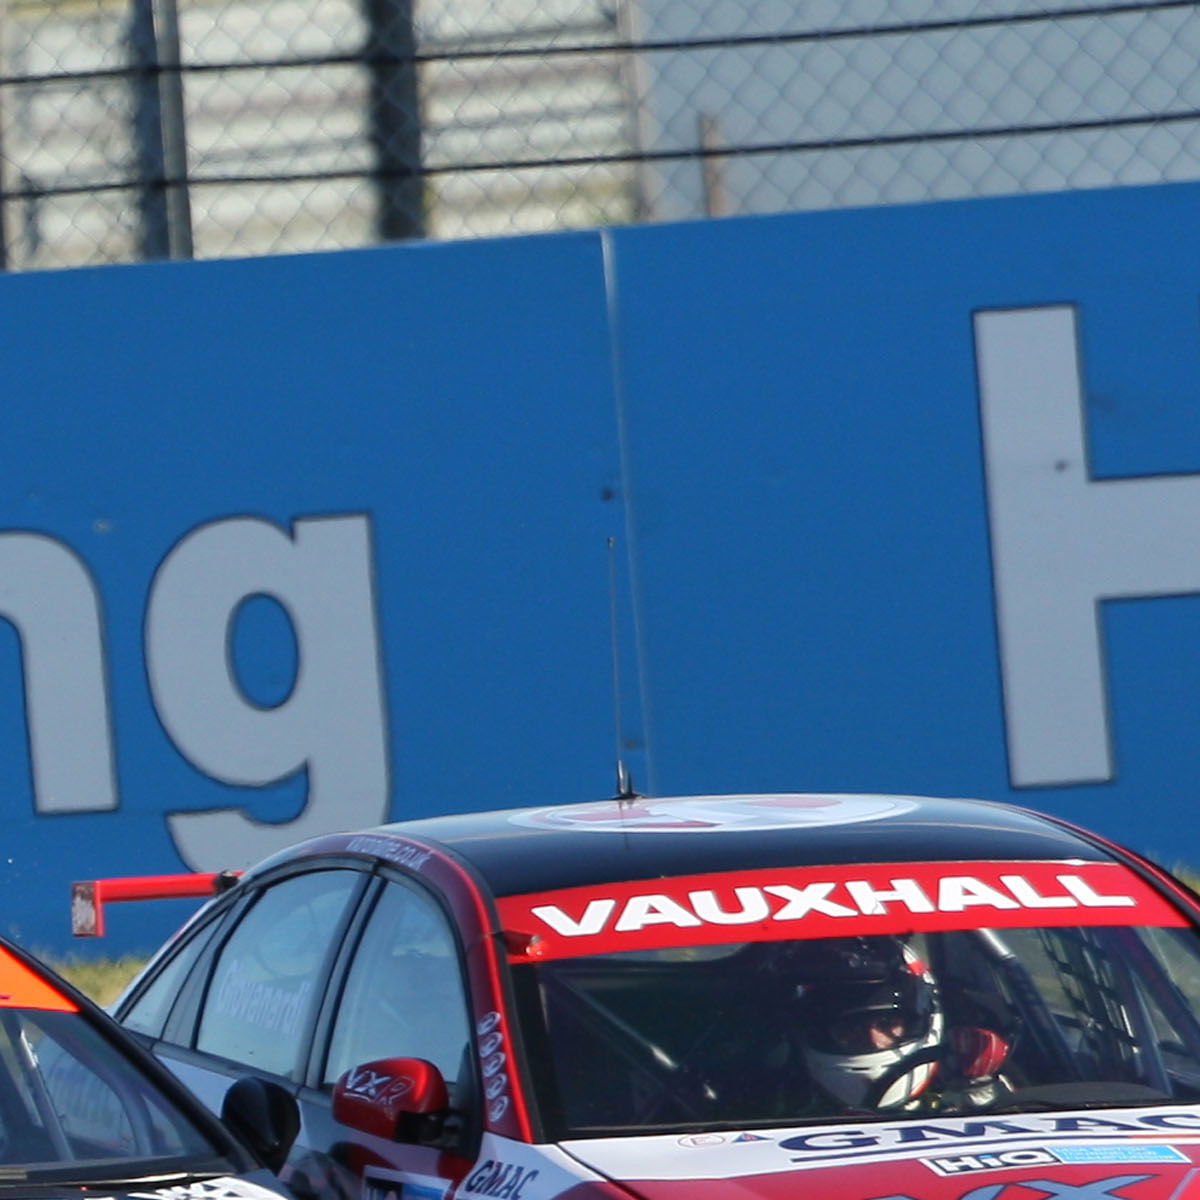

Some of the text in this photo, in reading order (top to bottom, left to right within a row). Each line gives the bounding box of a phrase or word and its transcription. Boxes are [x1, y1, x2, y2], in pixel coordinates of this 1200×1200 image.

[531, 874, 1133, 937] VAUXHALL
[778, 1113, 1200, 1151] GMAC
[464, 1159, 540, 1200] GMAC
[934, 1150, 1060, 1174] HiQ
